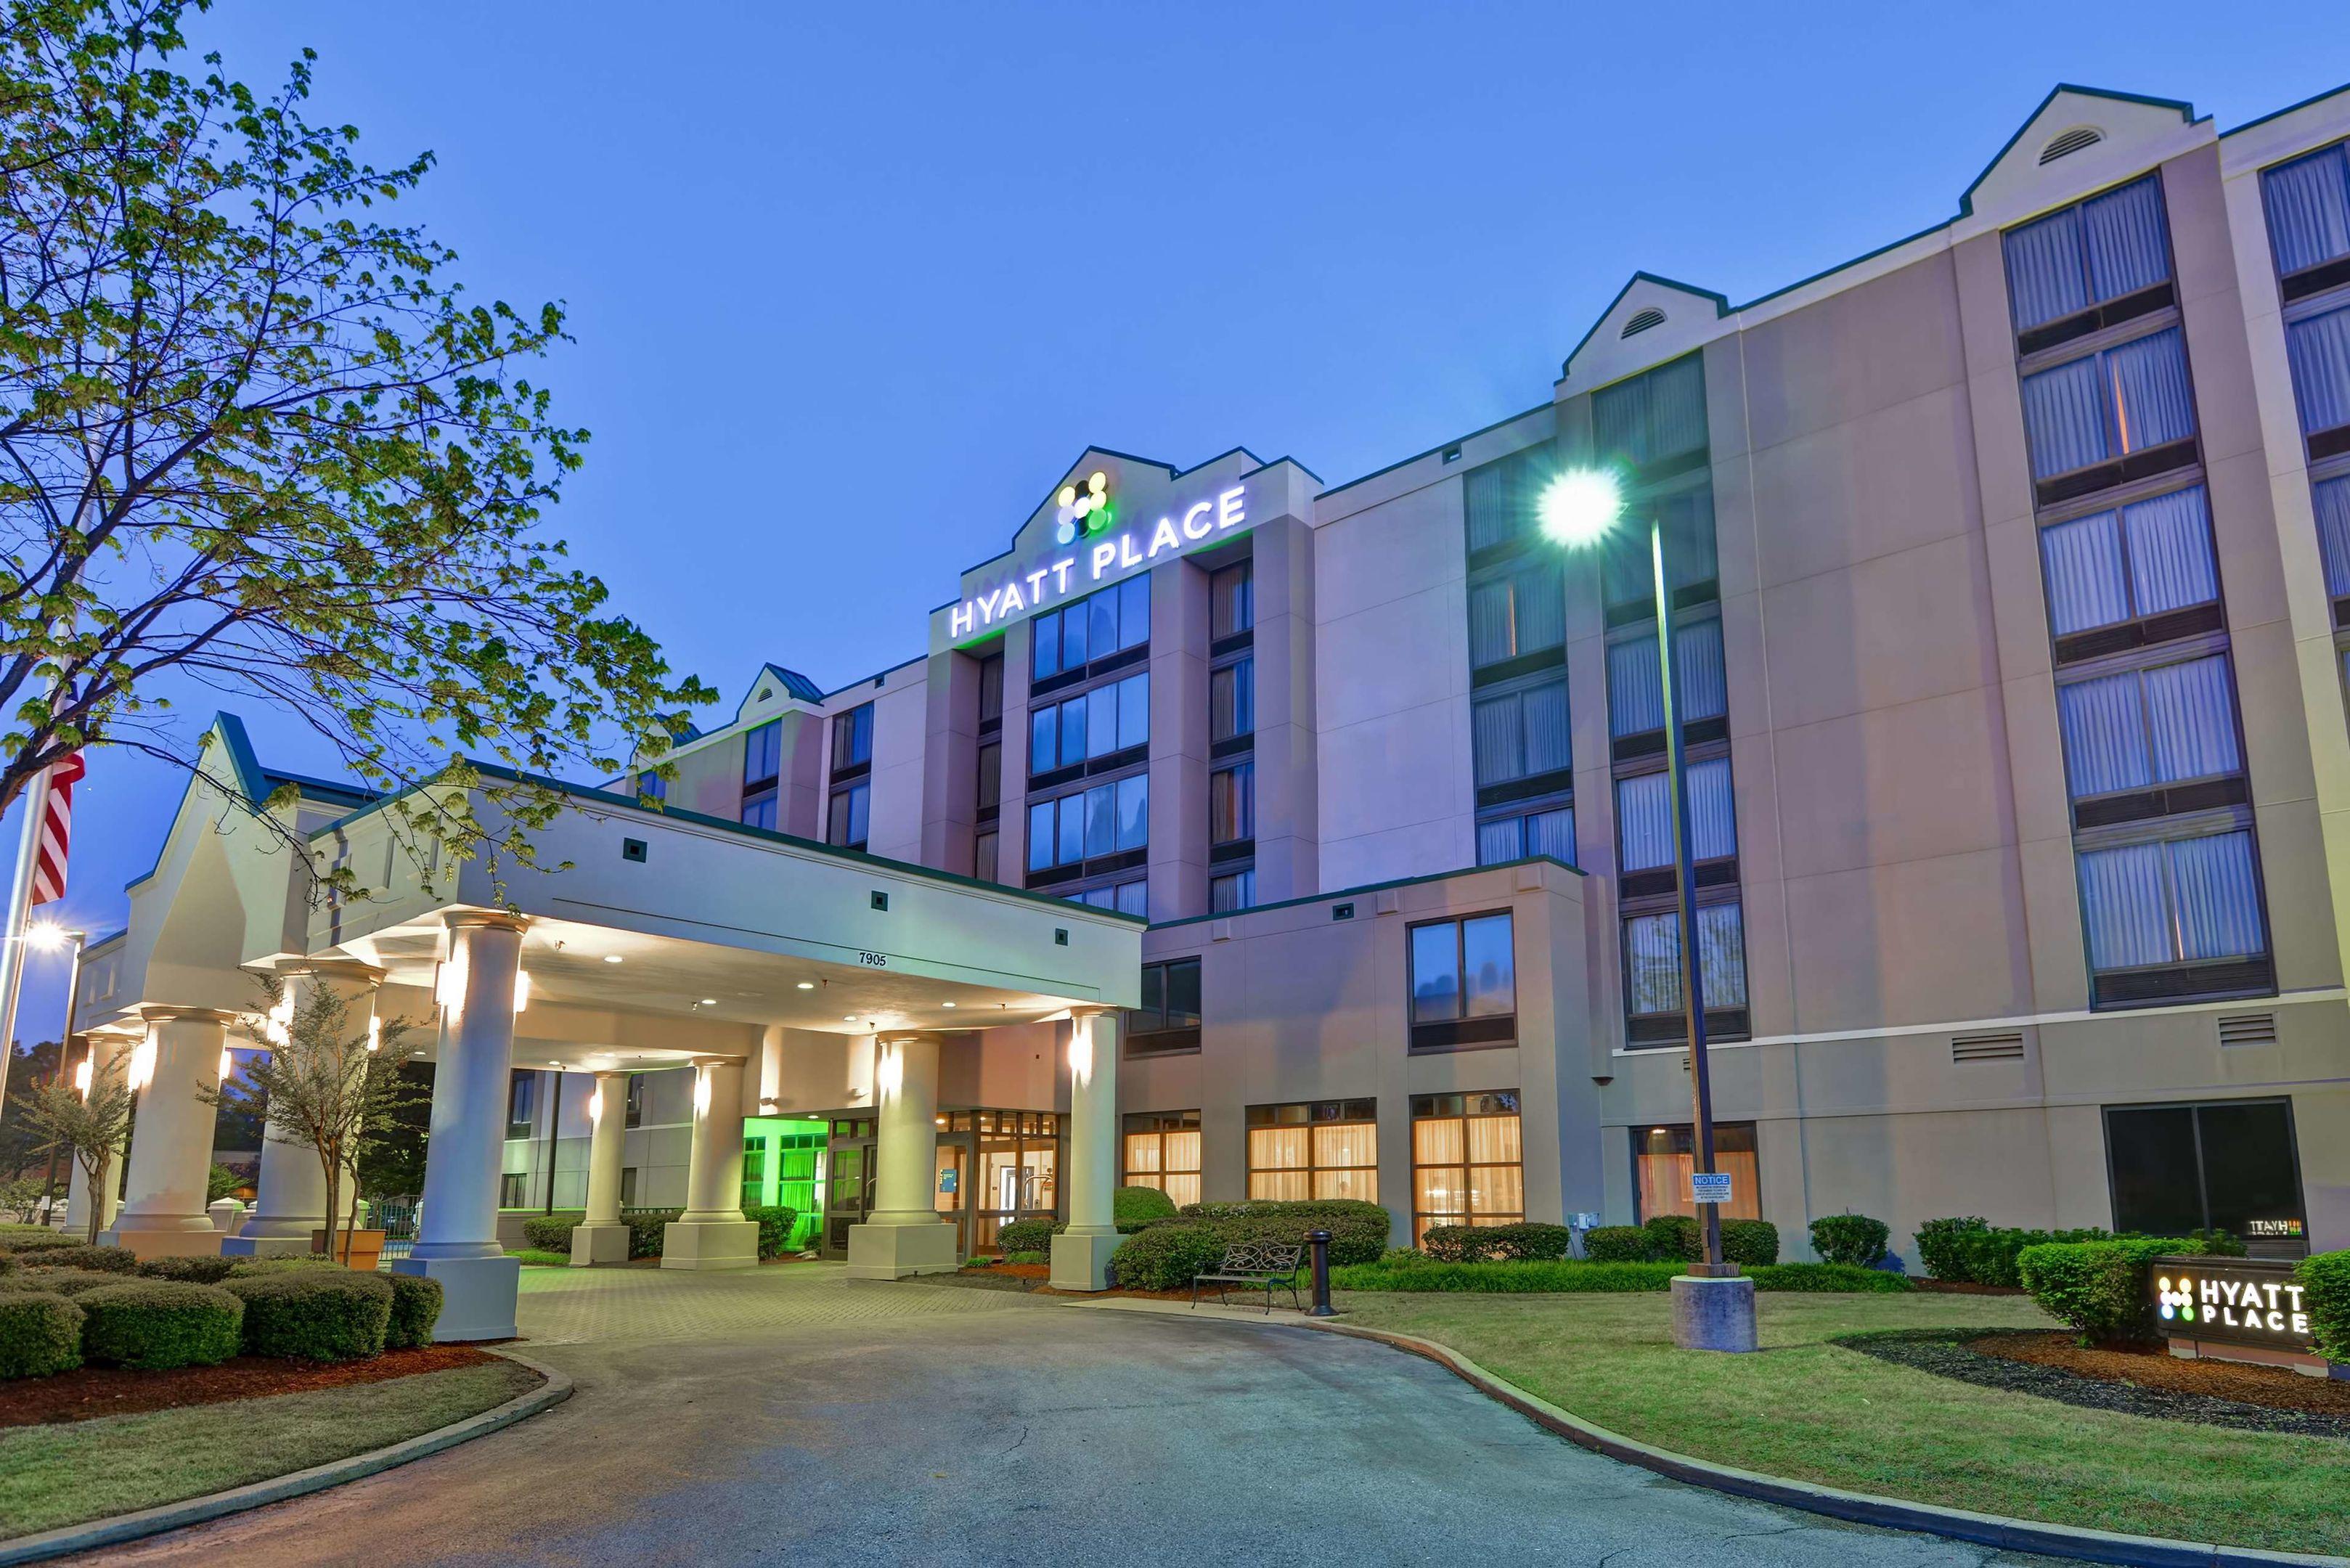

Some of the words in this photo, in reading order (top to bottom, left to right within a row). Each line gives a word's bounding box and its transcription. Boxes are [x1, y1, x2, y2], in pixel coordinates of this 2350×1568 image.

[951, 558, 1075, 638] HYATT
[1093, 485, 1245, 580] PLACE
[860, 952, 886, 966] 7905
[1694, 1176, 1729, 1185] NOTICE
[2200, 1279, 2304, 1311] HYATT
[2202, 1304, 2309, 1334] PLACE
